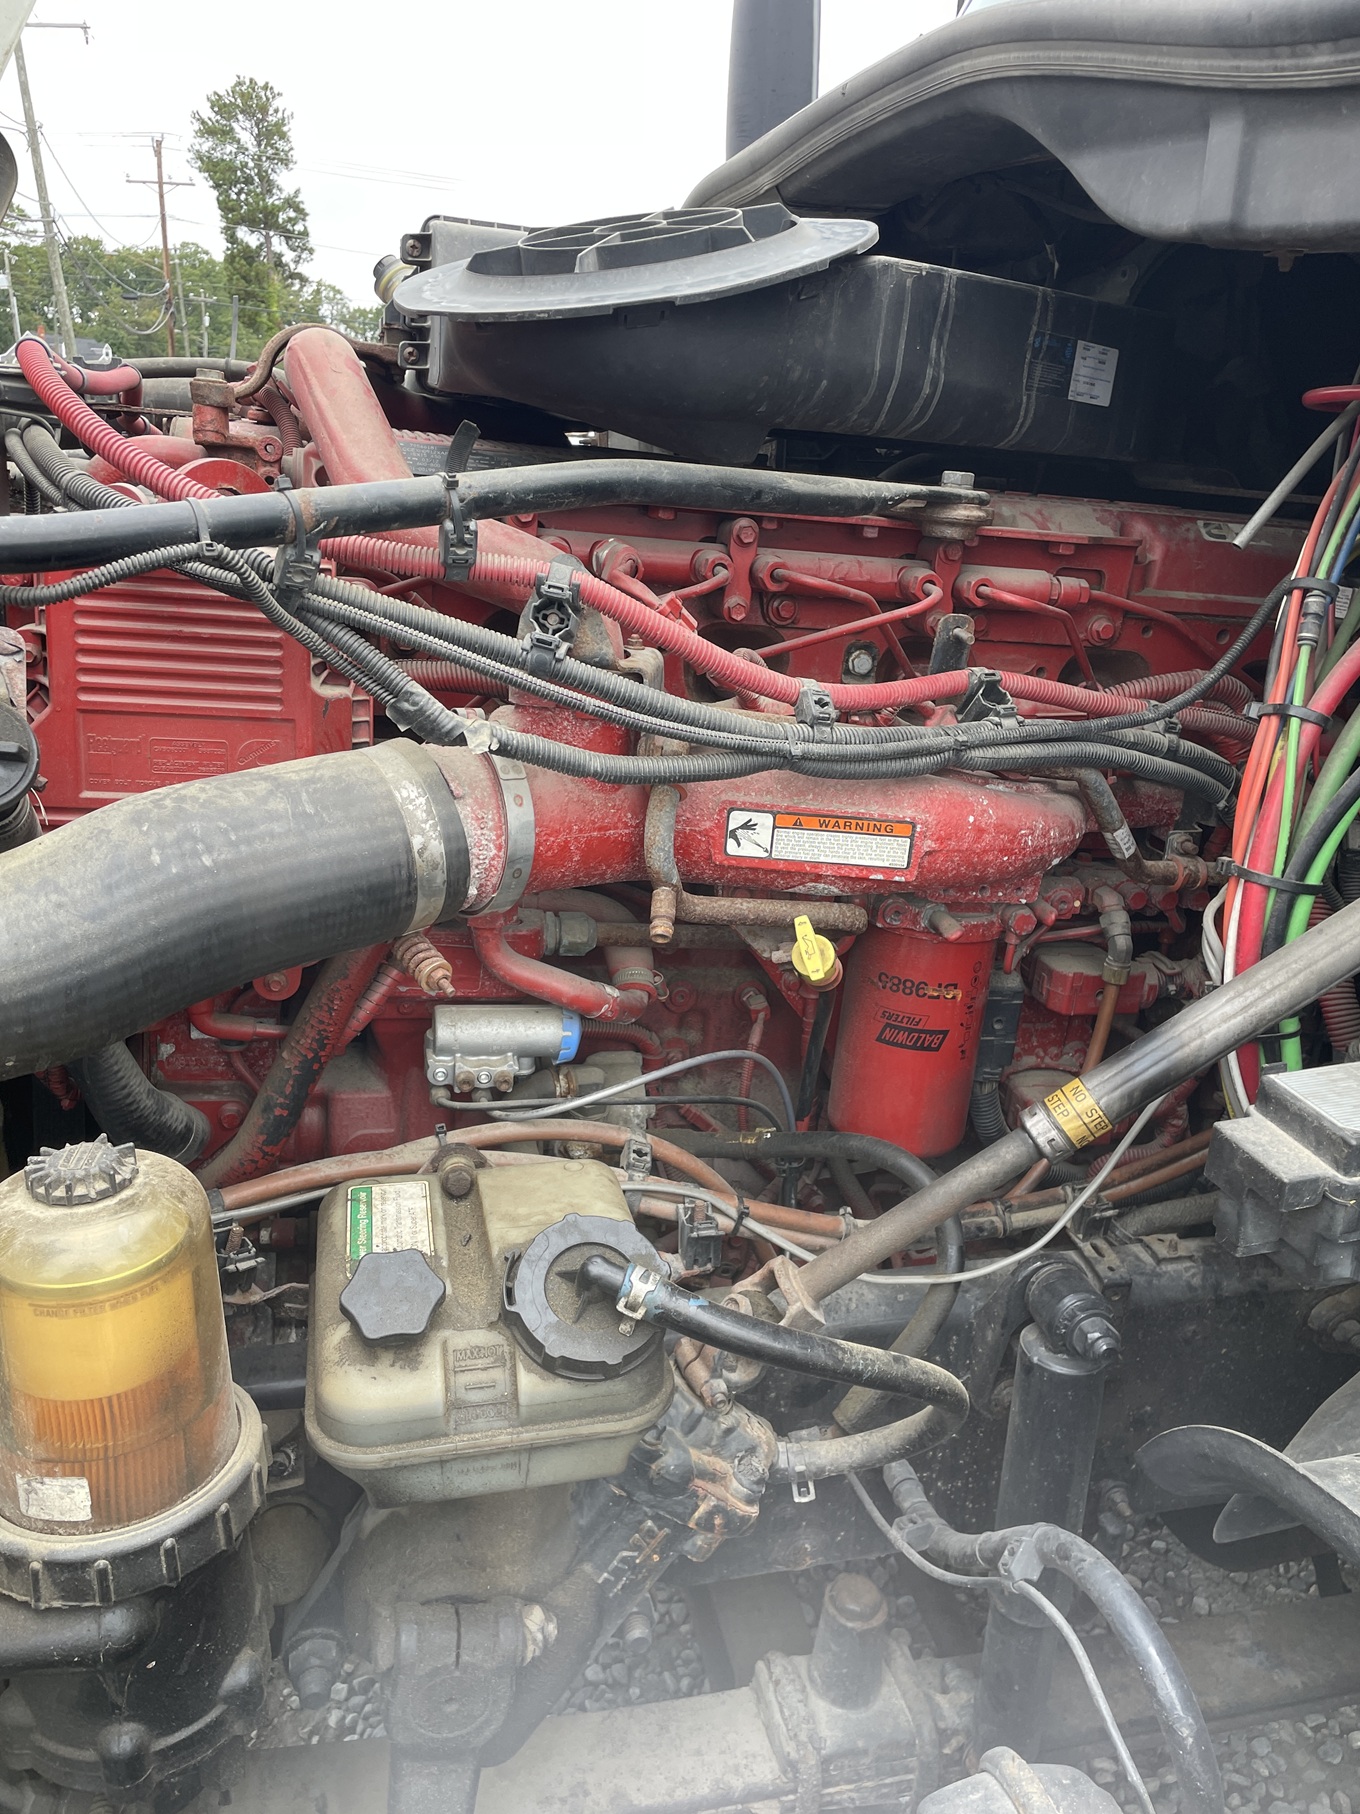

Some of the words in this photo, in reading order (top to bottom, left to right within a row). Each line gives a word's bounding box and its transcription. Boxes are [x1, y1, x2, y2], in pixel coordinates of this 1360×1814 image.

[818, 818, 894, 834] WARNING
[880, 1010, 922, 1026] FILTERS
[882, 1027, 944, 1048] BALDWIN
[1048, 1094, 1070, 1118] STEP
[1070, 1085, 1086, 1102] NO
[1086, 1108, 1108, 1131] STEP
[357, 1192, 367, 1218] Reservoir
[357, 1219, 368, 1244] Steering
